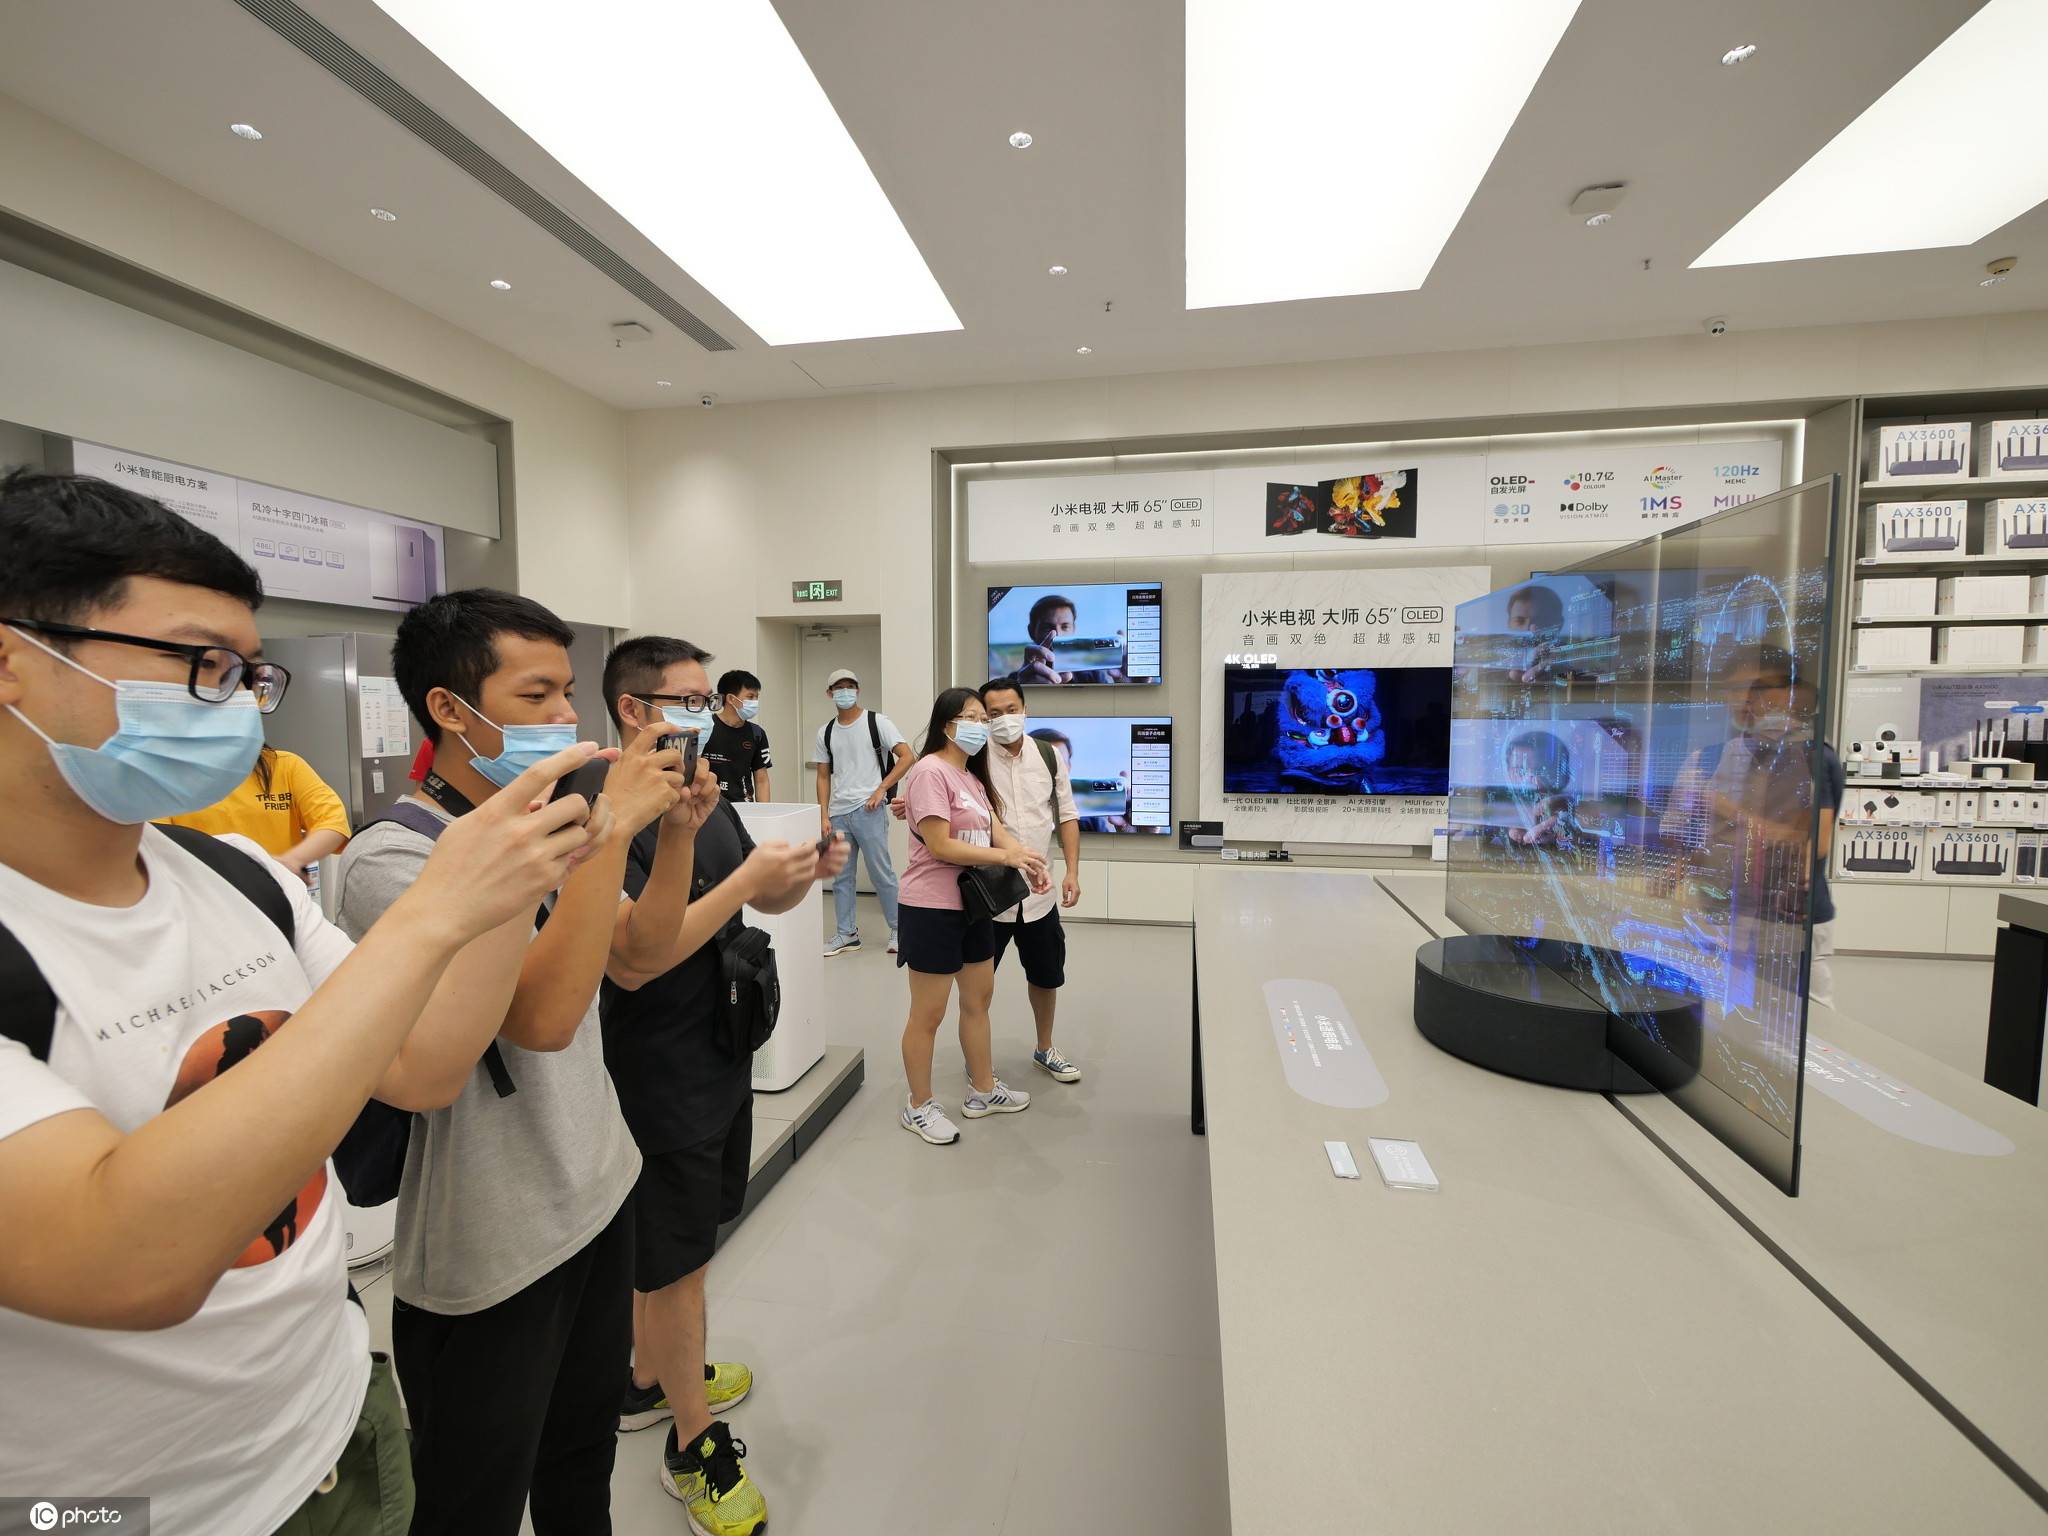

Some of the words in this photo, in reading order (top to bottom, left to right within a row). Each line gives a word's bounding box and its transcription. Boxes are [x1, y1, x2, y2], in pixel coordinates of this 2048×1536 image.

[1896, 429, 1955, 441] AX3600
[114, 462, 208, 491] 小米智能厨电方案
[1578, 471, 1615, 482] 10.7亿
[1713, 465, 1760, 477] 120Hz
[1490, 475, 1528, 486] OLED
[1491, 485, 1527, 495] 自发光屏
[1050, 502, 1107, 516] 小米电视
[1111, 500, 1139, 514] 大师
[1575, 502, 1609, 513] Dolby
[1640, 495, 1682, 511] 1MS
[252, 502, 329, 527] 风冷十字四门冰箱
[1511, 504, 1531, 515] 3D
[1892, 506, 1952, 518] AX3600
[825, 589, 838, 597] EXIT
[1241, 609, 1316, 627] 小米电视
[1322, 608, 1360, 626] 大师
[1406, 610, 1439, 620] OLED
[1224, 653, 1241, 664] 4K
[1243, 653, 1278, 664] OLED
[256, 793, 277, 802] THE
[1855, 830, 1909, 841] AX3600
[1944, 832, 1999, 843] AX3600
[196, 952, 277, 1003] JACKSON
